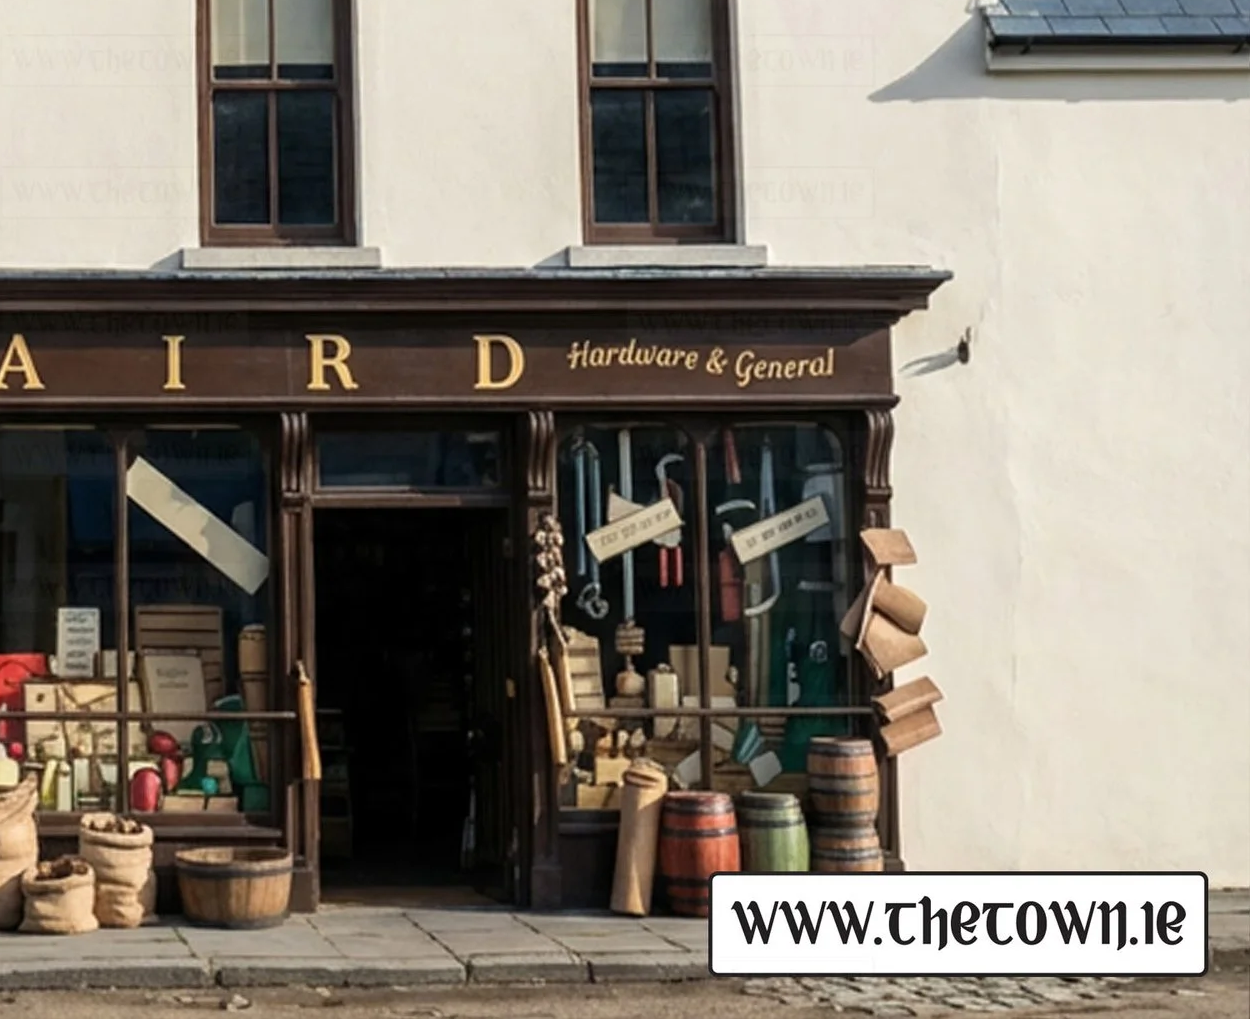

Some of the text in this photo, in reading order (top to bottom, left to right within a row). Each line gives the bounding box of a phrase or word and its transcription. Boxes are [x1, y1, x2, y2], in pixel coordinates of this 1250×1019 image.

[567, 338, 835, 388] Hardware & General
